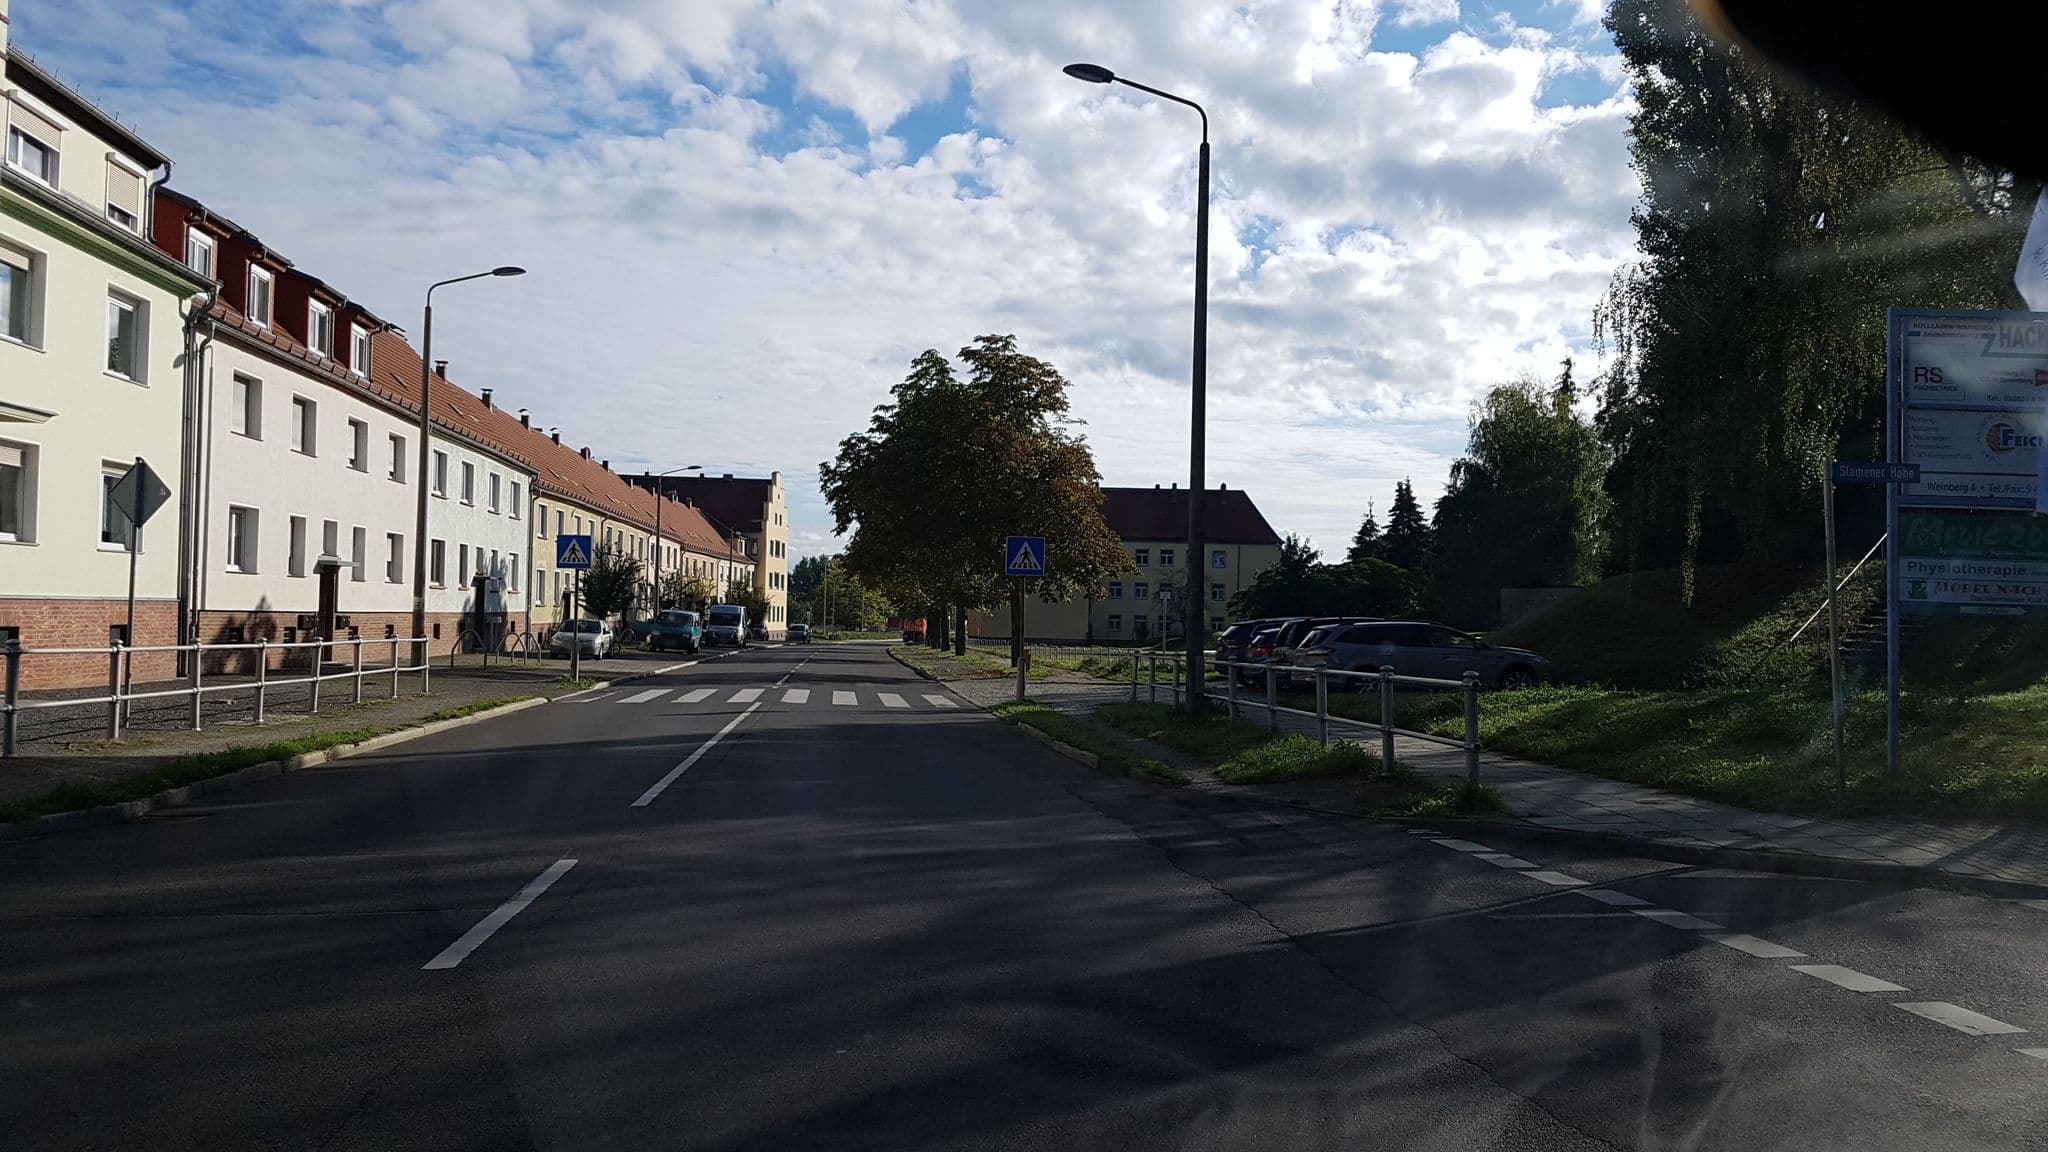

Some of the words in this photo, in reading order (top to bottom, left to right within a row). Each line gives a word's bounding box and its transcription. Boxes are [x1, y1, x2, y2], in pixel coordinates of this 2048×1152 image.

[1914, 366, 1943, 383] RS
[1927, 481, 1968, 494] Weinberg
[1908, 561, 2026, 577] Physiotherapie
